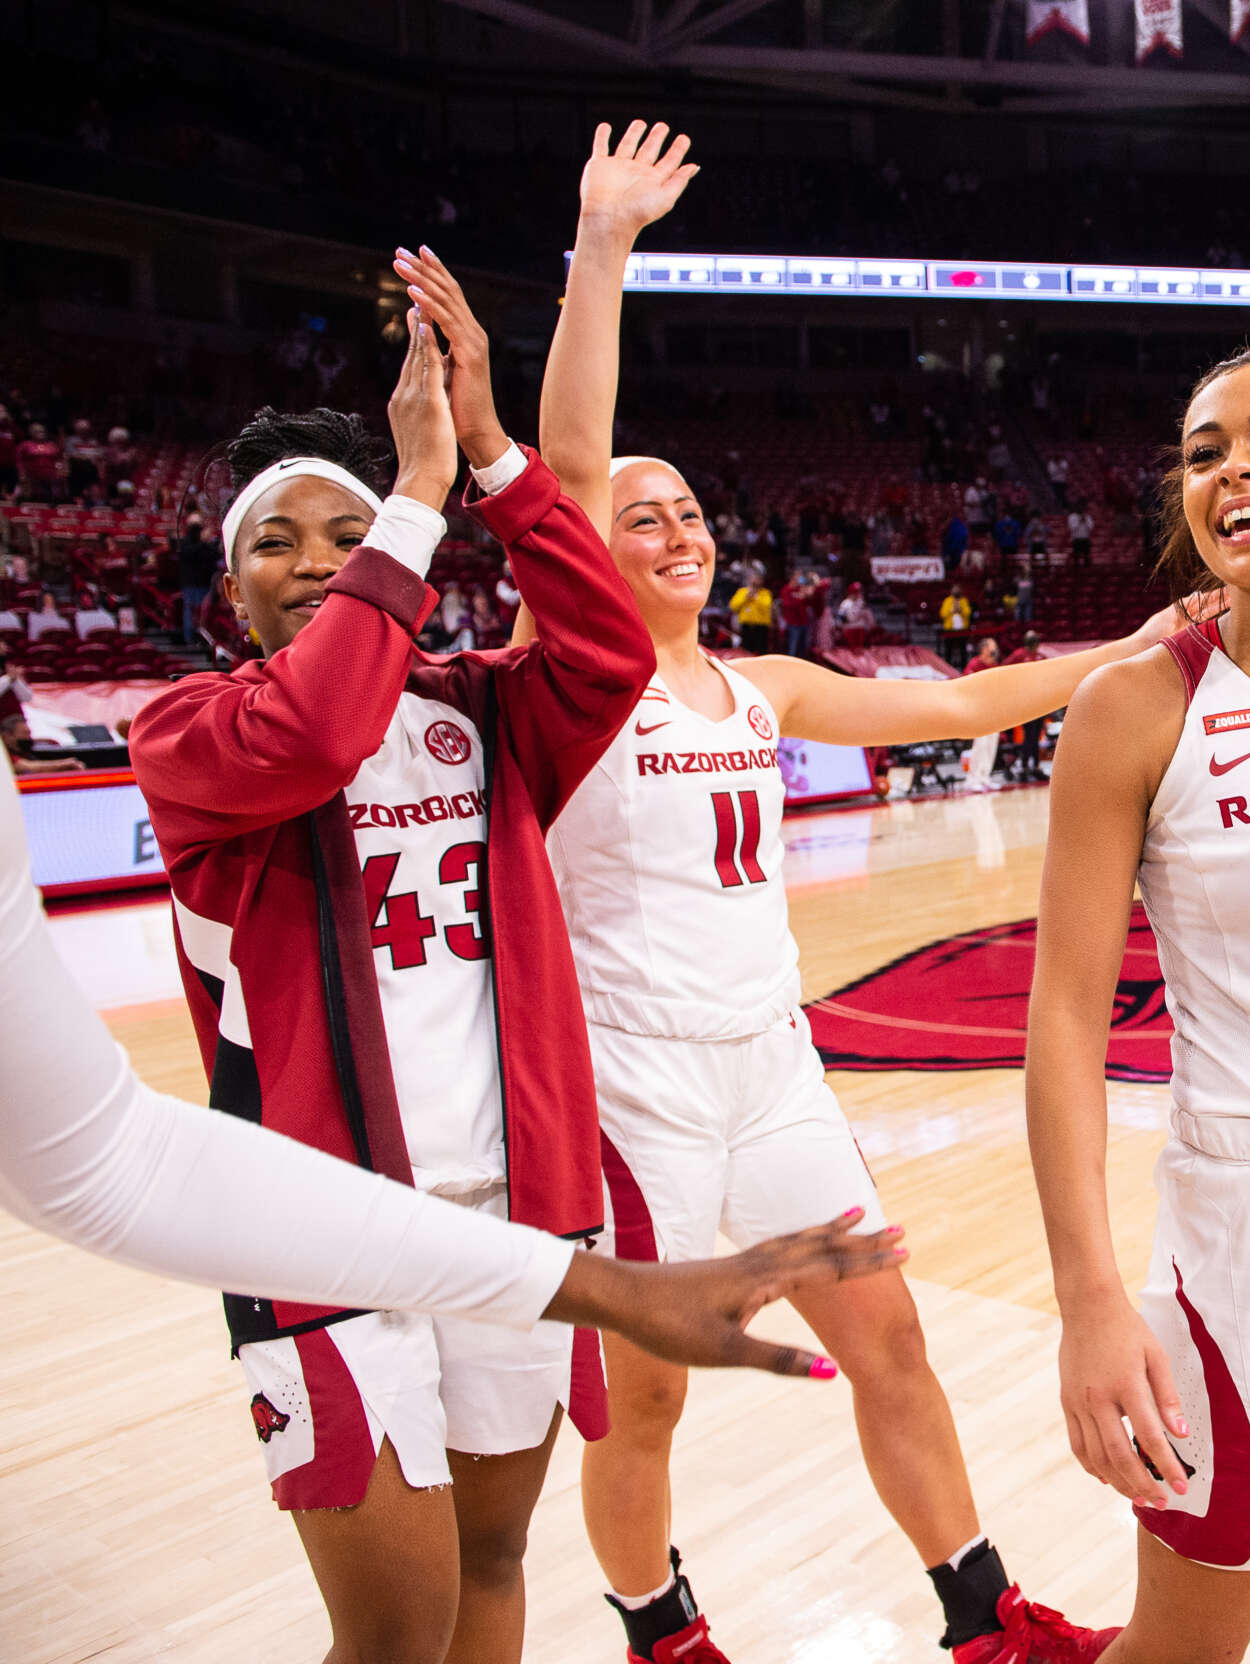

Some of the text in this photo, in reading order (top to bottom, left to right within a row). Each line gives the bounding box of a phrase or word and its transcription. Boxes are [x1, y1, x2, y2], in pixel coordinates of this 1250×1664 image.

[428, 724, 467, 762] SEC
[710, 790, 768, 888] 11
[362, 841, 491, 970] 43
